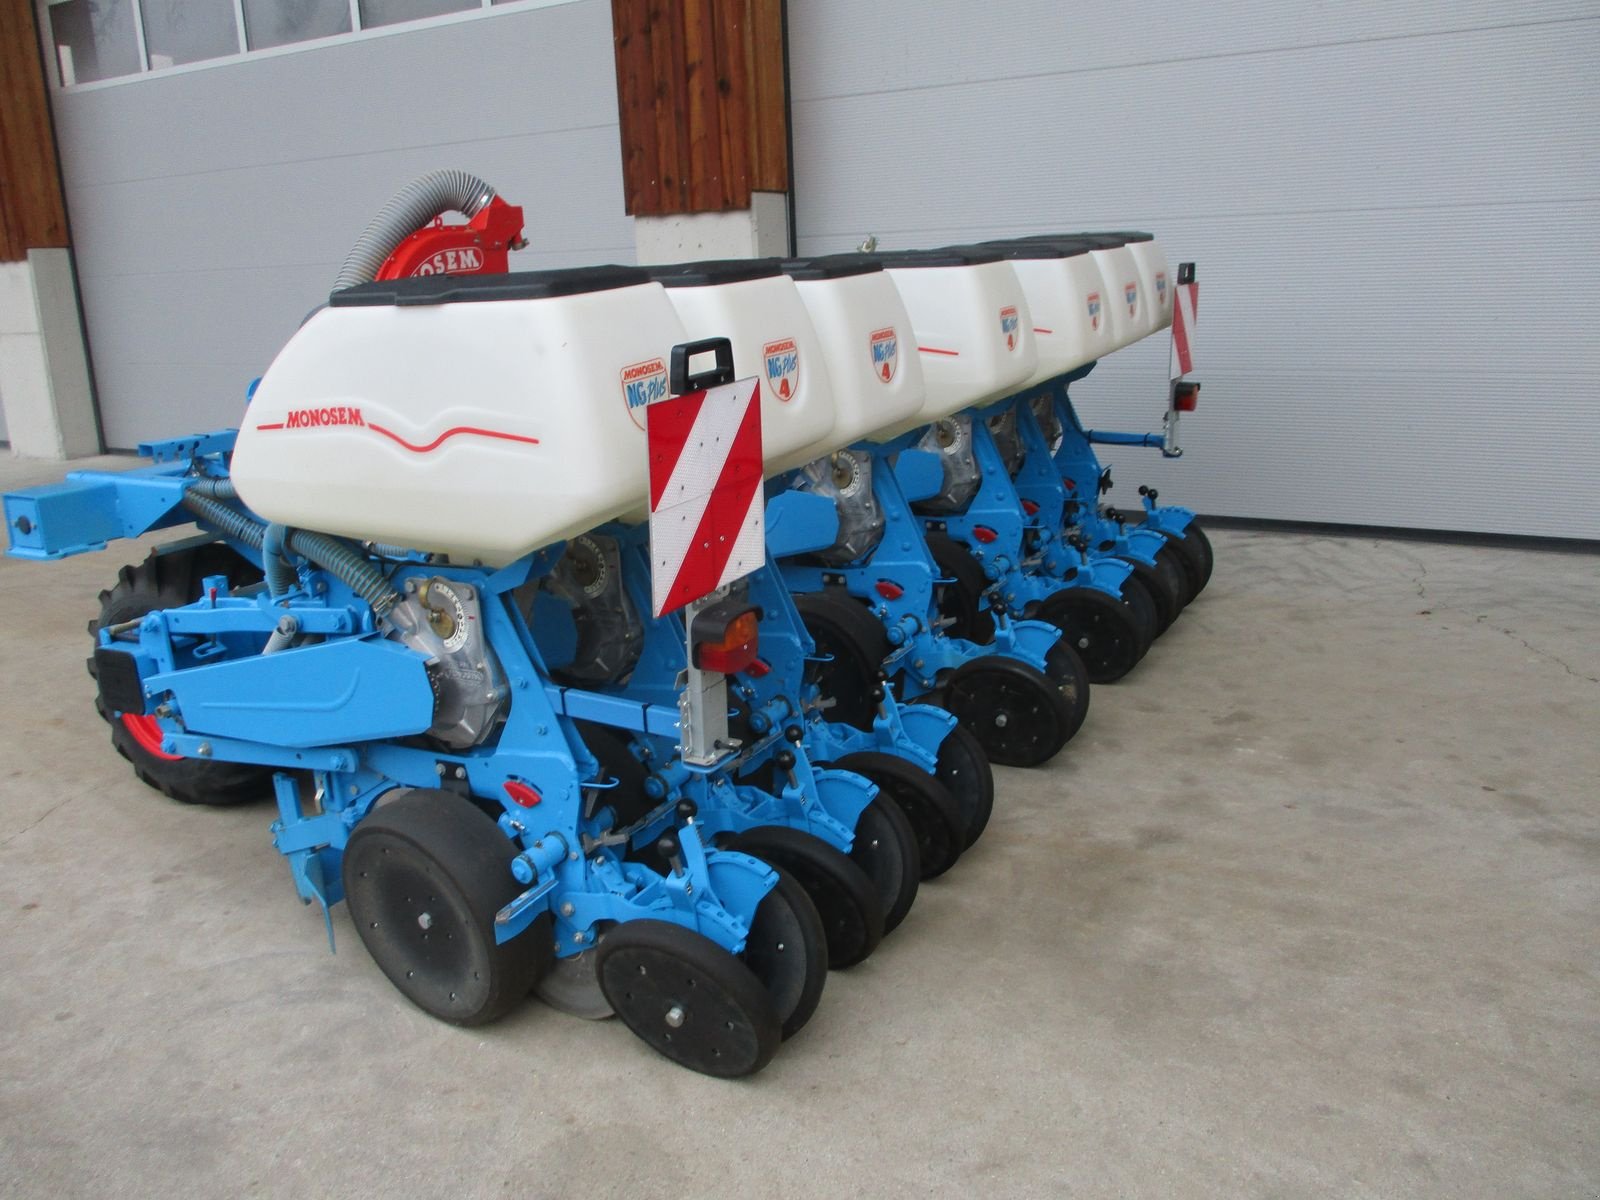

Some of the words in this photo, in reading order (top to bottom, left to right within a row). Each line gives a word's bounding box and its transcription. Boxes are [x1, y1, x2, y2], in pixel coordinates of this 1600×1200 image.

[413, 249, 480, 277] OSEM
[765, 340, 795, 354] MONOSEM
[623, 360, 664, 380] MONOSEM
[767, 356, 782, 379] NG
[882, 362, 890, 379] 4
[626, 381, 647, 408] NG
[779, 378, 790, 398] 4
[286, 406, 365, 429] MONOSEM
